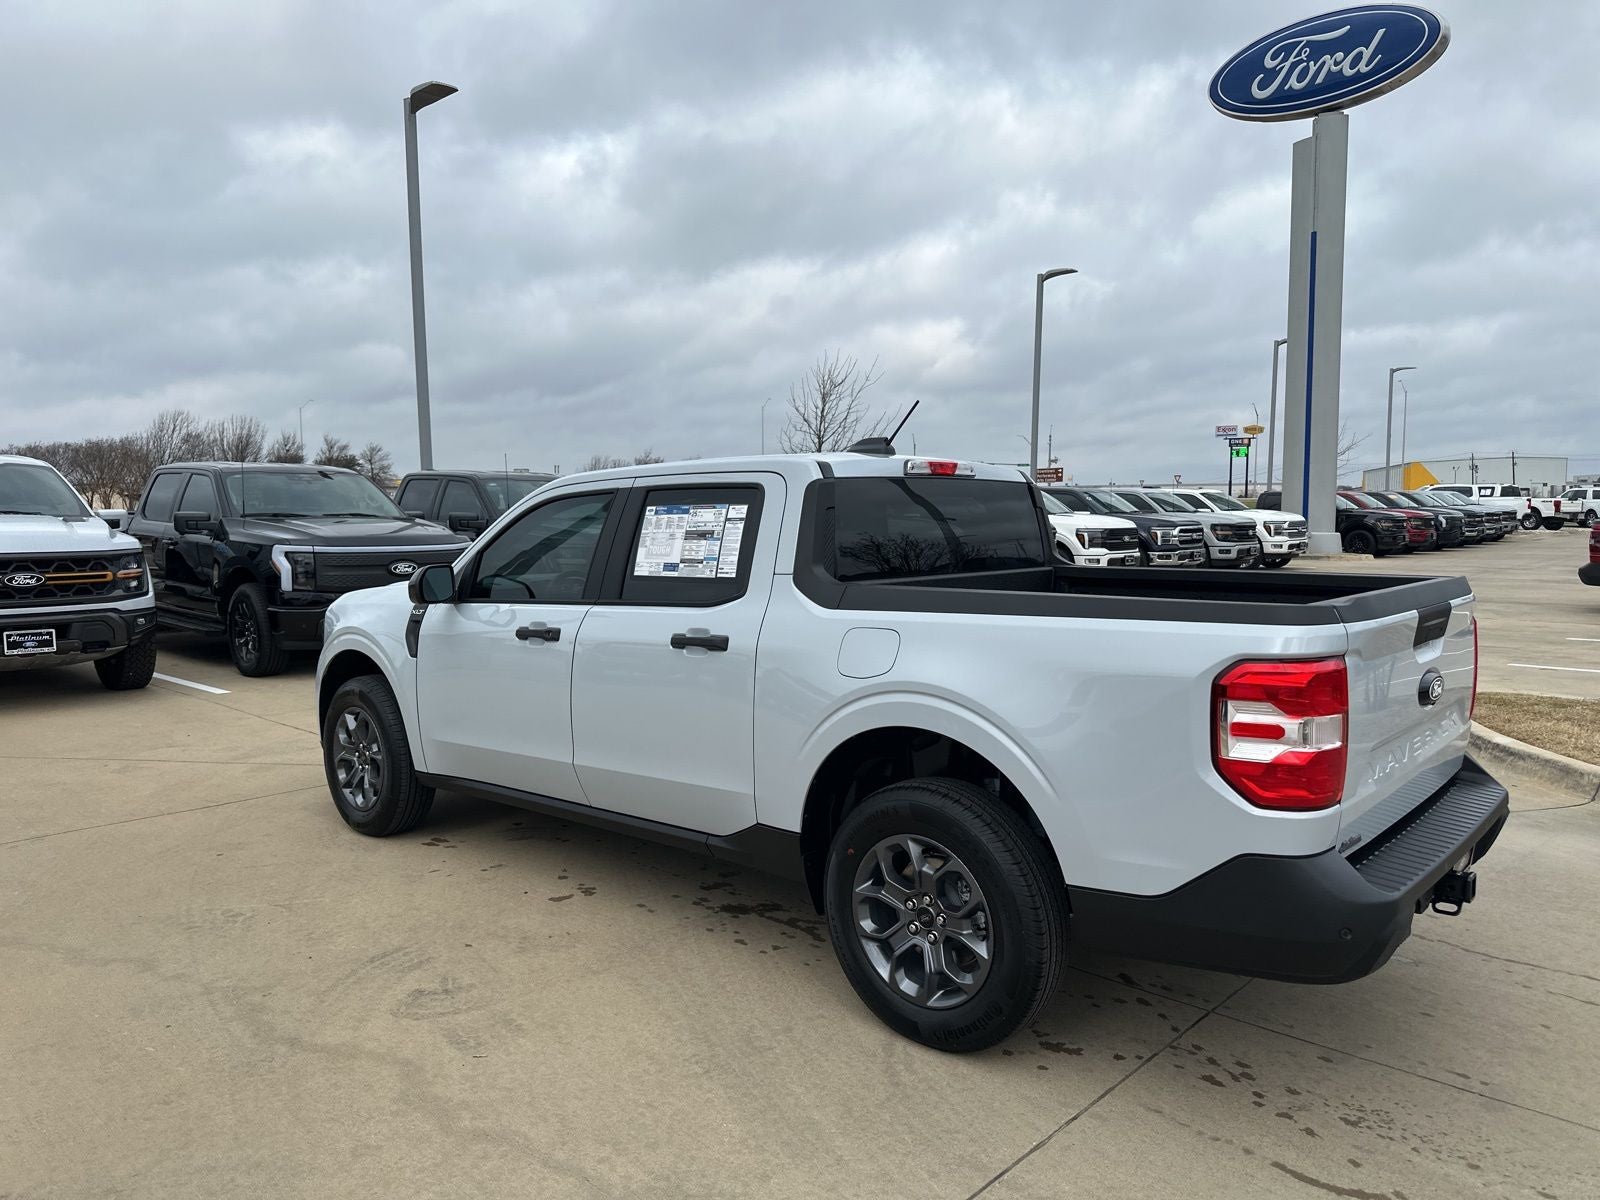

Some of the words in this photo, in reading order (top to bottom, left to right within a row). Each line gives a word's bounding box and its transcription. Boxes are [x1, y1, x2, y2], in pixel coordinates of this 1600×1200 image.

[1251, 25, 1386, 99] Ford
[1216, 426, 1236, 434] Exxon
[396, 564, 413, 573] Ford
[12, 575, 37, 585] Ford
